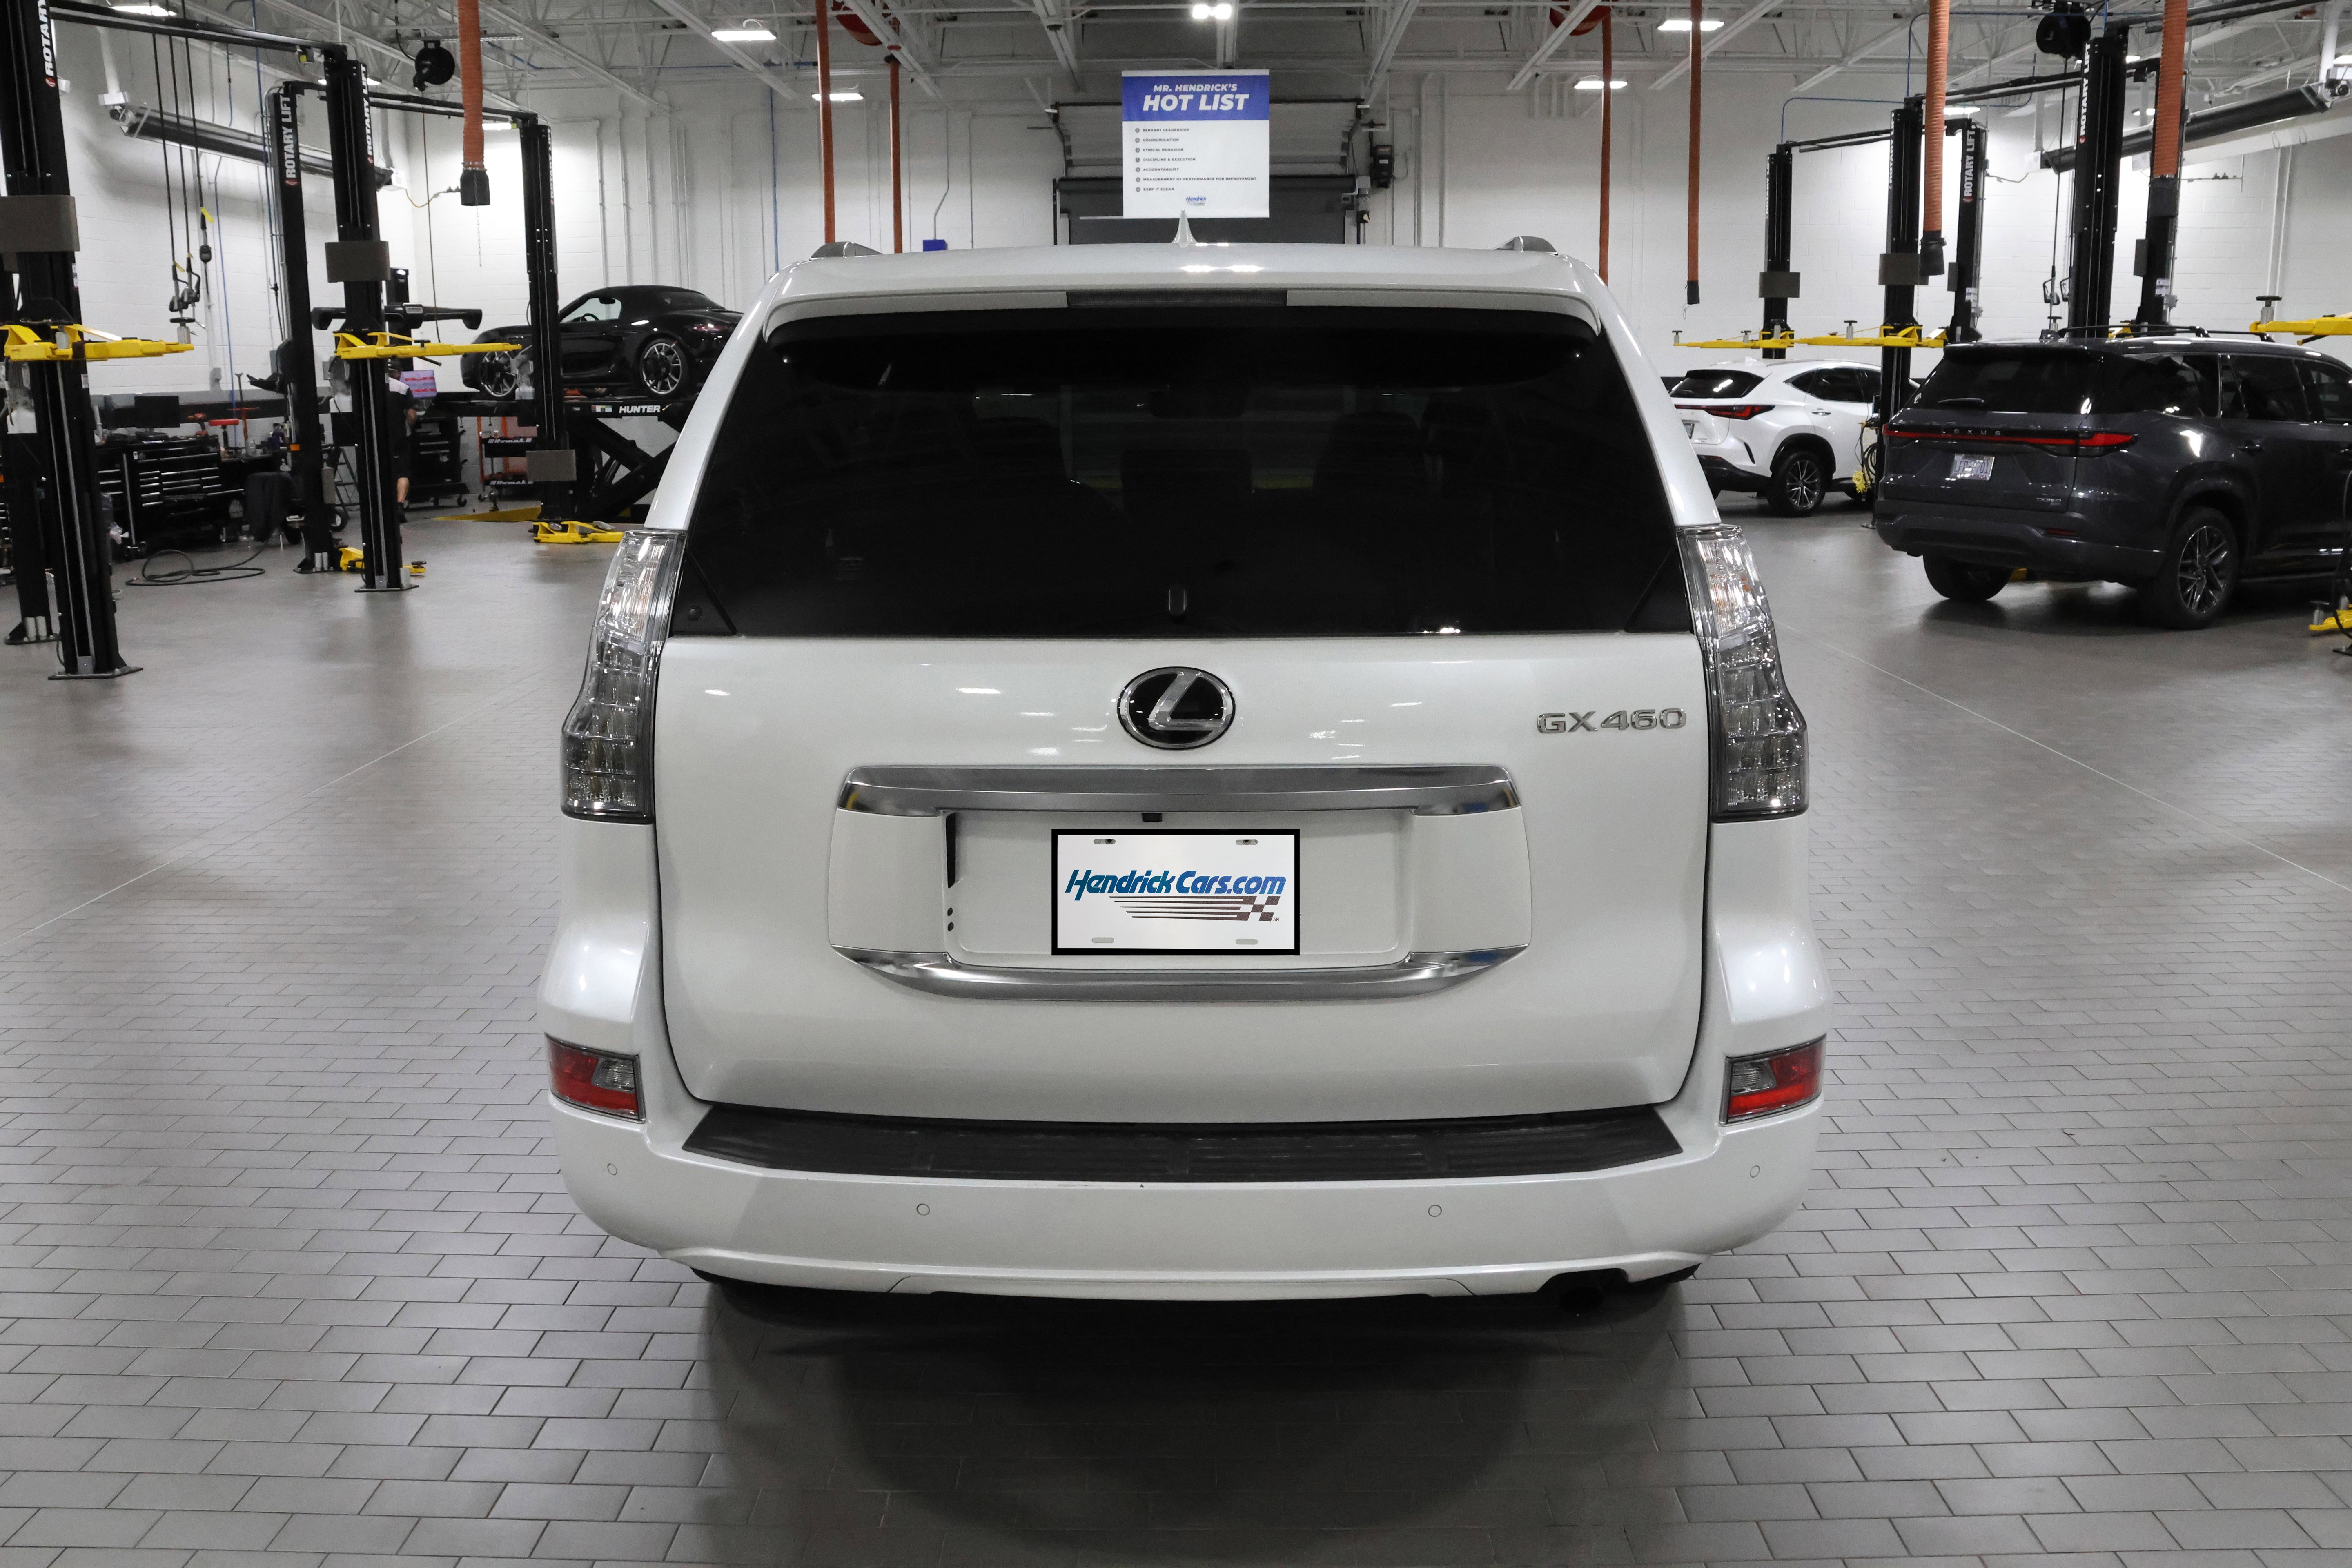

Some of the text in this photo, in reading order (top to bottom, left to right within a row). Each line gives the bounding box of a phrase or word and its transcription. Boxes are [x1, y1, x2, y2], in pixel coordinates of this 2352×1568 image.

[1143, 94, 1250, 111] HOT LIST
[1175, 84, 1238, 92] HENDRICK'S
[2080, 77, 2089, 136] ROTARY
[280, 95, 296, 178] ROTARY LIFT
[363, 98, 372, 156] ROTARY
[1964, 129, 1976, 197] ROTARY LIFT
[619, 405, 661, 413] HUNTER
